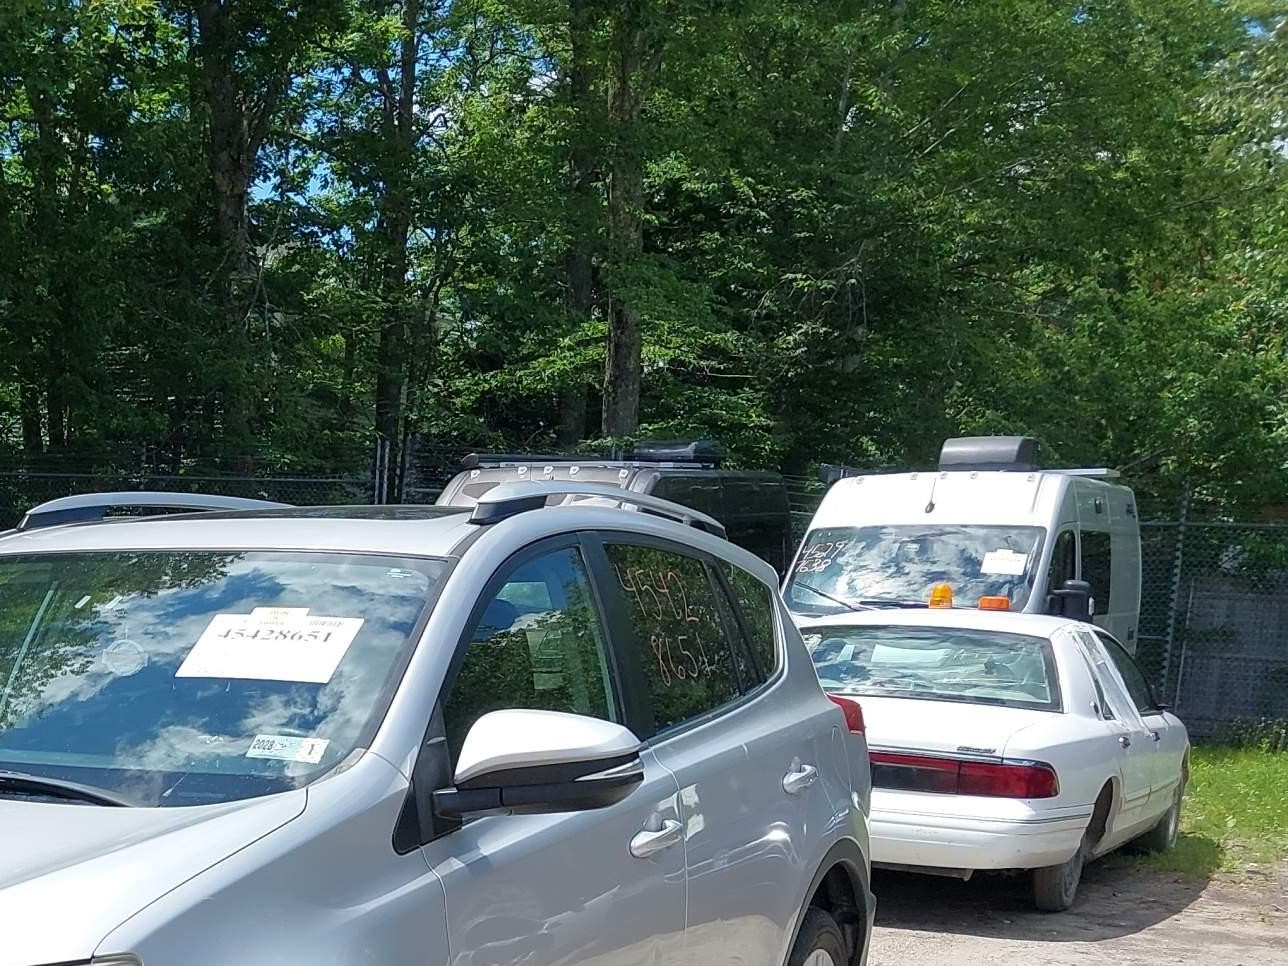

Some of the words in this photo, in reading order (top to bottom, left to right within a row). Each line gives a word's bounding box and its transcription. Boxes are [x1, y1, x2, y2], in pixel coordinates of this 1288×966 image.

[802, 540, 848, 560] 4529
[614, 563, 700, 623] 4542
[218, 628, 333, 643] 45428651
[650, 631, 712, 687] 8651
